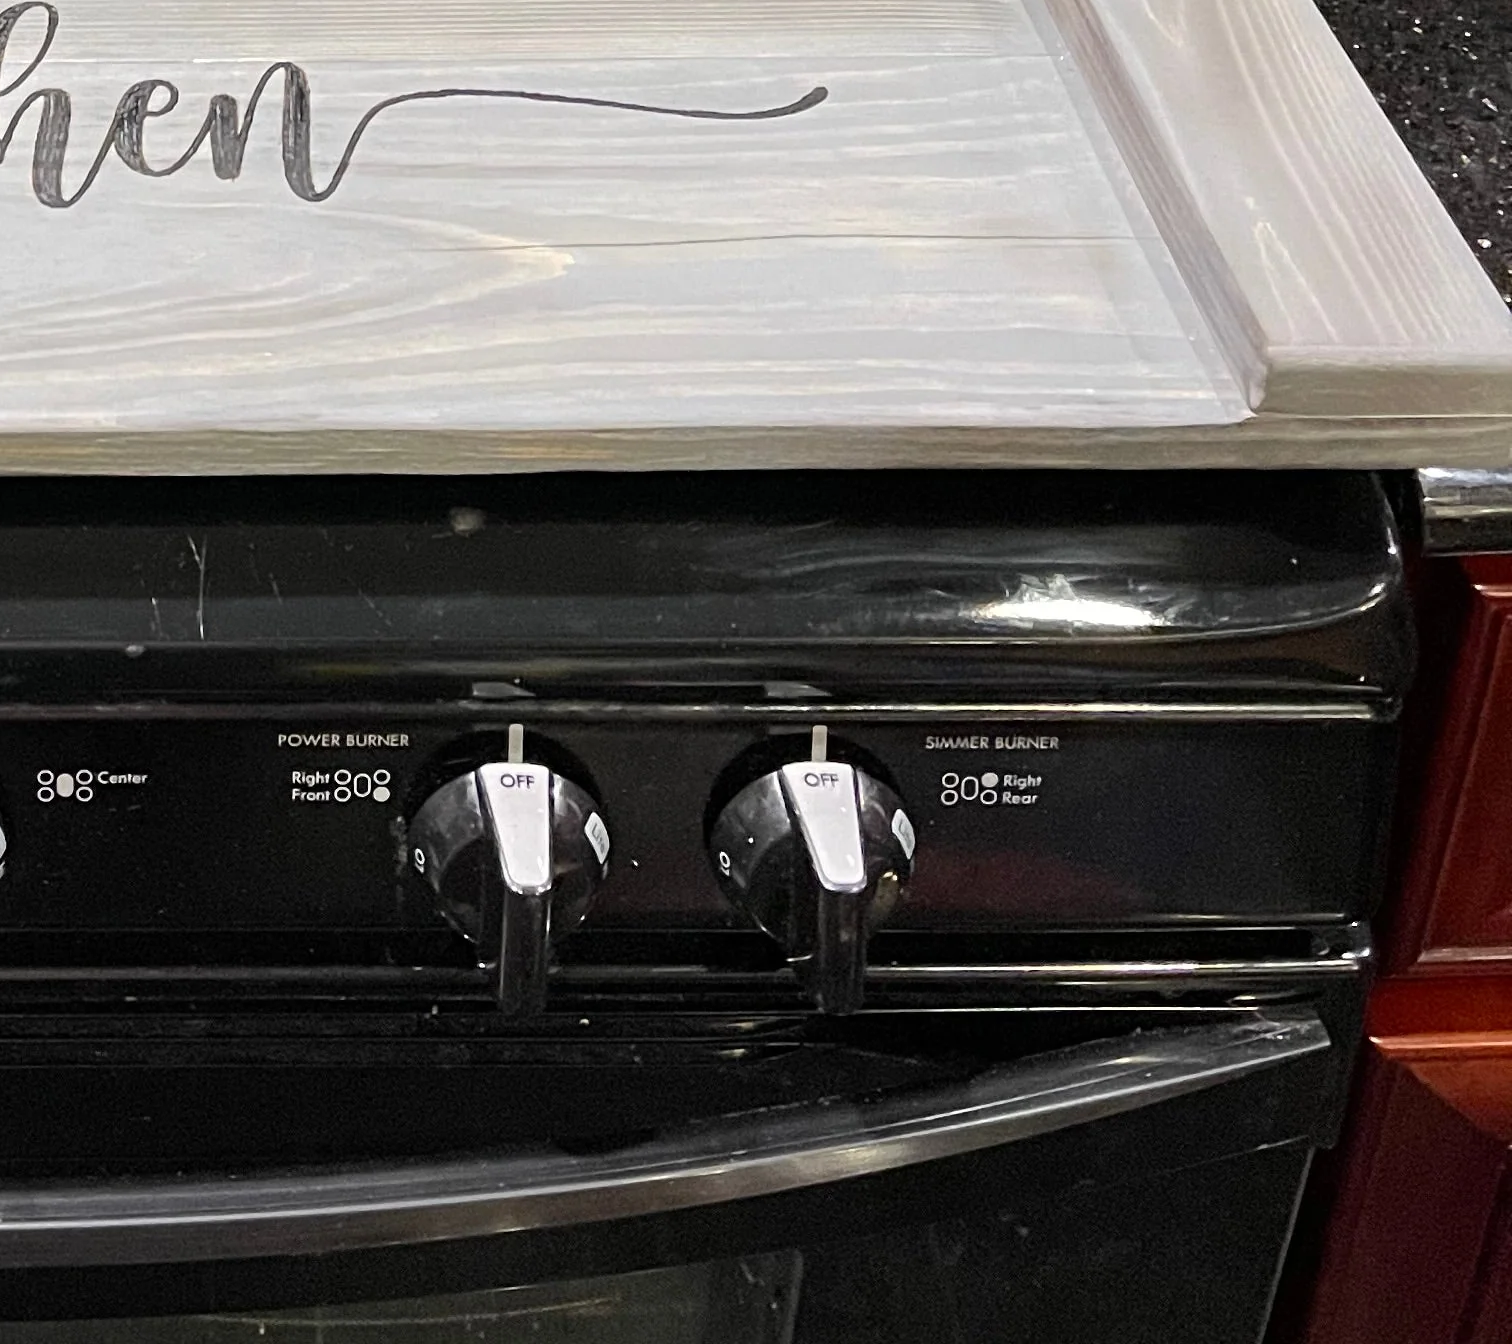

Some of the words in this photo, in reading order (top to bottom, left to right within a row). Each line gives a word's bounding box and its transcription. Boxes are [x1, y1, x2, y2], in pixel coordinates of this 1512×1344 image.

[277, 733, 340, 747] POWER
[346, 733, 409, 747] BURNER
[925, 736, 989, 749] SIMMER
[995, 736, 1059, 750] BURNER
[97, 771, 149, 785] Center
[291, 771, 330, 786] Right
[500, 773, 535, 789] OFF
[804, 772, 839, 788] OFF
[1003, 774, 1042, 790] Right
[291, 788, 330, 801] Front
[1002, 792, 1038, 805] Rear
